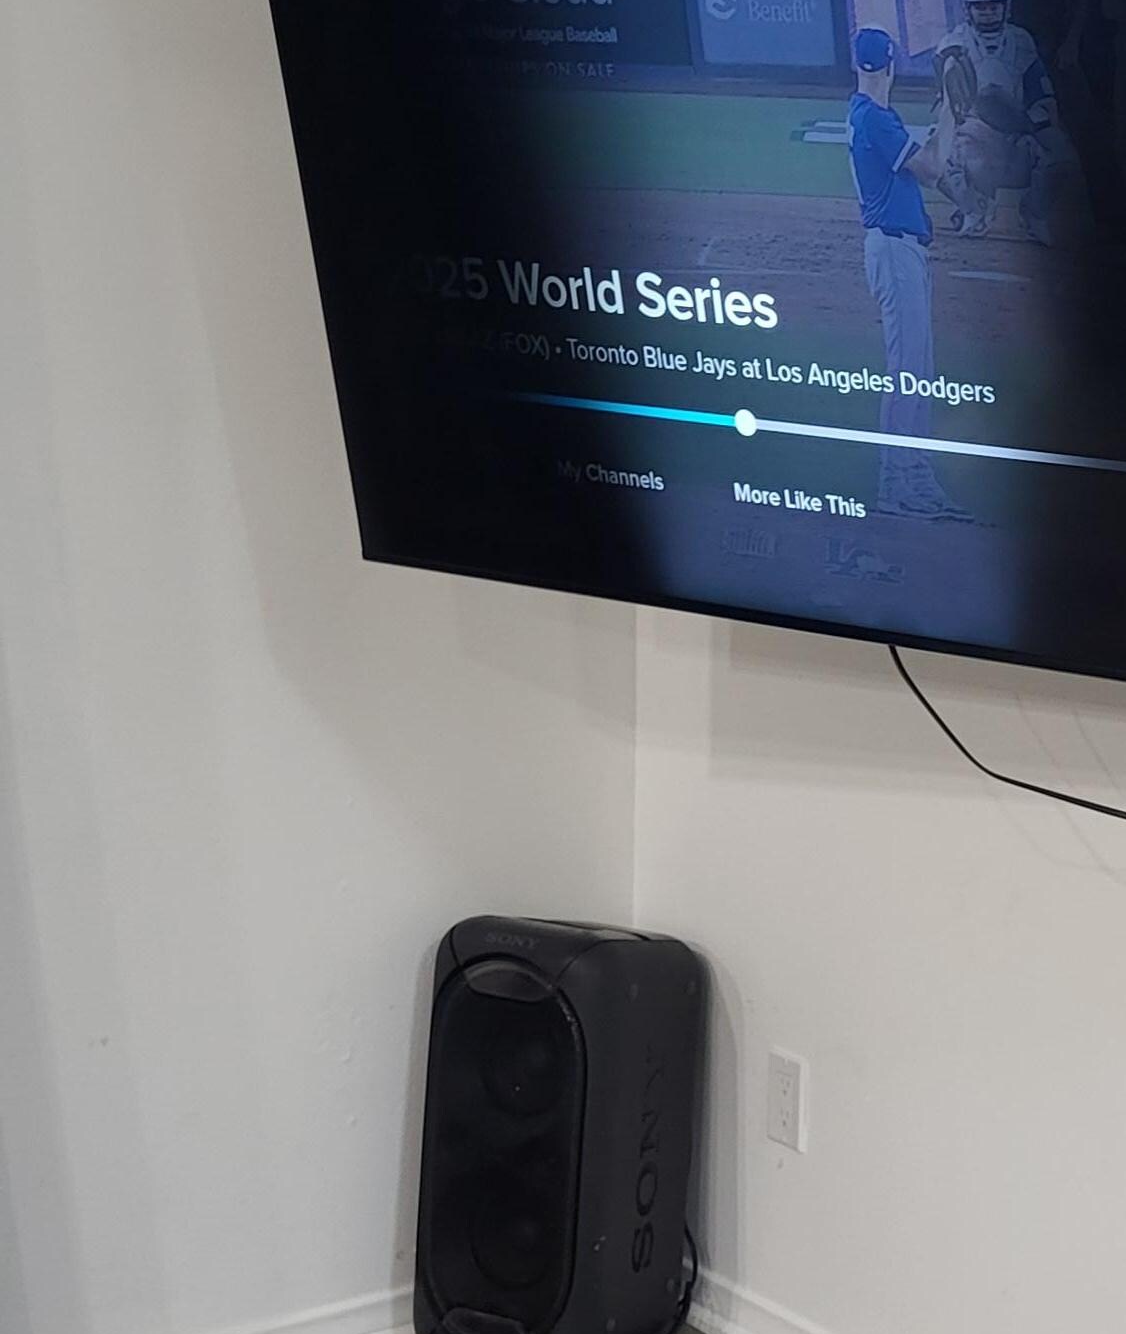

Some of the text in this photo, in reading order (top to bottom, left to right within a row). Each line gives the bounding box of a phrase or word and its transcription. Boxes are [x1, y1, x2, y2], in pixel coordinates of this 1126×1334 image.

[497, 259, 625, 315] World
[637, 271, 779, 330] Series
[566, 338, 639, 366] Toronto
[643, 345, 688, 371] Blue
[692, 351, 738, 380] Jays
[742, 357, 763, 379] at
[766, 358, 803, 384] Los
[807, 362, 895, 394] Angeles
[899, 371, 996, 406] Dodgers
[585, 463, 665, 491] Channels
[732, 481, 868, 519] More Like This
